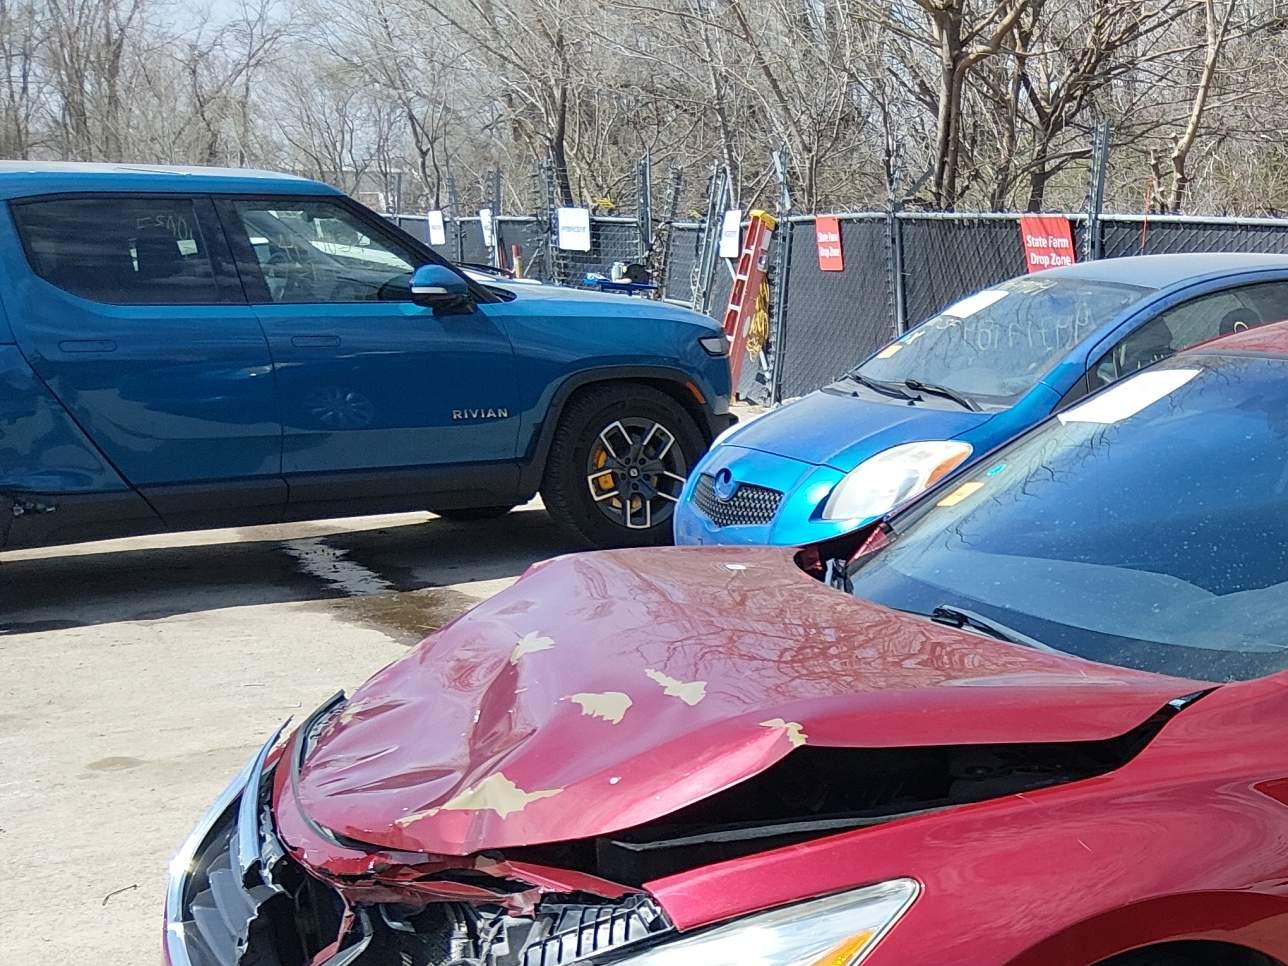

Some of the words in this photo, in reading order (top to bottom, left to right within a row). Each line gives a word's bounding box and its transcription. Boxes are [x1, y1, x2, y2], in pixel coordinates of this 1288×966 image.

[1026, 234, 1047, 248] State
[1048, 235, 1069, 249] Farm
[1030, 252, 1049, 268] Drop
[1050, 253, 1072, 266] Zone
[452, 408, 508, 419] RIVIAN
